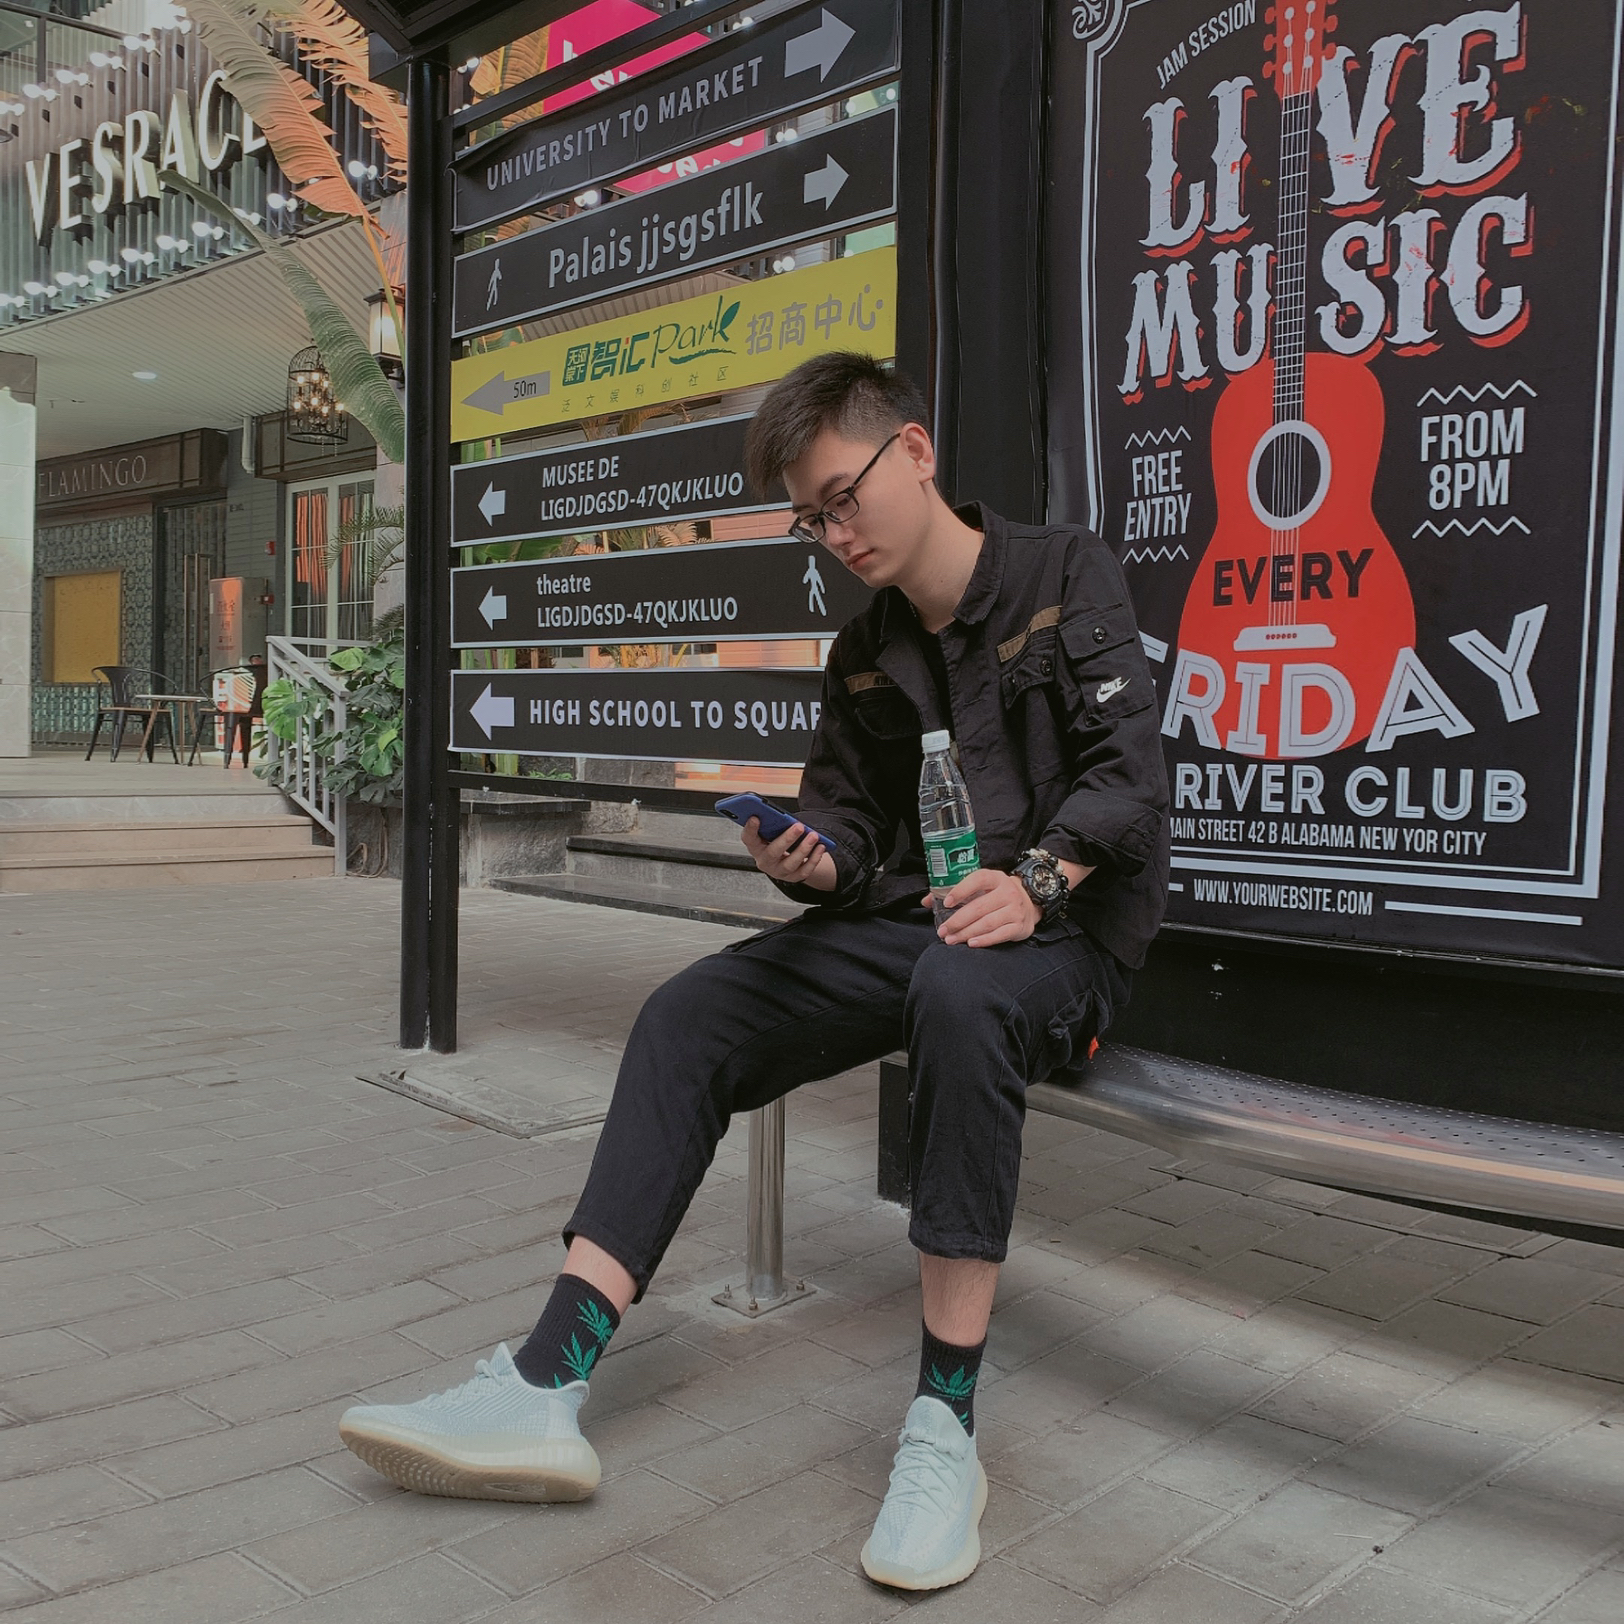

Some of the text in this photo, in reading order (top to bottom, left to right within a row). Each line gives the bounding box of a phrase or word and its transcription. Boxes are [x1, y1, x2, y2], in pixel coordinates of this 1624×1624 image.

[1156, 0, 1256, 90] JAM SESSION
[487, 118, 611, 191] UNIVERSITY
[619, 104, 649, 138] TO
[658, 56, 763, 124] MARKET
[1139, 2, 1523, 252] LIVE
[549, 182, 763, 288] Palais jjsgsflk
[1117, 192, 1531, 398] MUSIC
[591, 295, 741, 381] 智汇 Park
[745, 284, 884, 356] 招商中心
[513, 380, 537, 399] 50m
[1421, 407, 1525, 462] FROM
[38, 455, 147, 498] FLAMINGO
[541, 472, 744, 521] LIGDJDGSD-47QKJKLUO
[542, 456, 620, 488] MUSEE DE
[1132, 450, 1183, 497] FREE
[1429, 459, 1510, 511] 8PM
[1124, 493, 1192, 541] ENTRY
[537, 574, 591, 595] theatre
[1213, 549, 1374, 606] EVERY
[537, 597, 738, 629] LIGDJDGSD-47QKJKLUO
[1101, 676, 1122, 693] NIKE
[530, 700, 580, 725] HIGH
[589, 700, 682, 728] SCHOOL
[691, 701, 723, 729] TO
[1175, 763, 1527, 823] RIVER CLUB
[1198, 819, 1245, 842] STREET
[1248, 821, 1265, 843] 42
[1269, 822, 1278, 844] B
[1281, 822, 1354, 848] ALABAMA
[1360, 826, 1398, 851] NEW
[1403, 828, 1438, 853] YOR
[1443, 830, 1487, 856] CITY
[1194, 878, 1373, 915] WWW.YOURWEBSITE.COM
